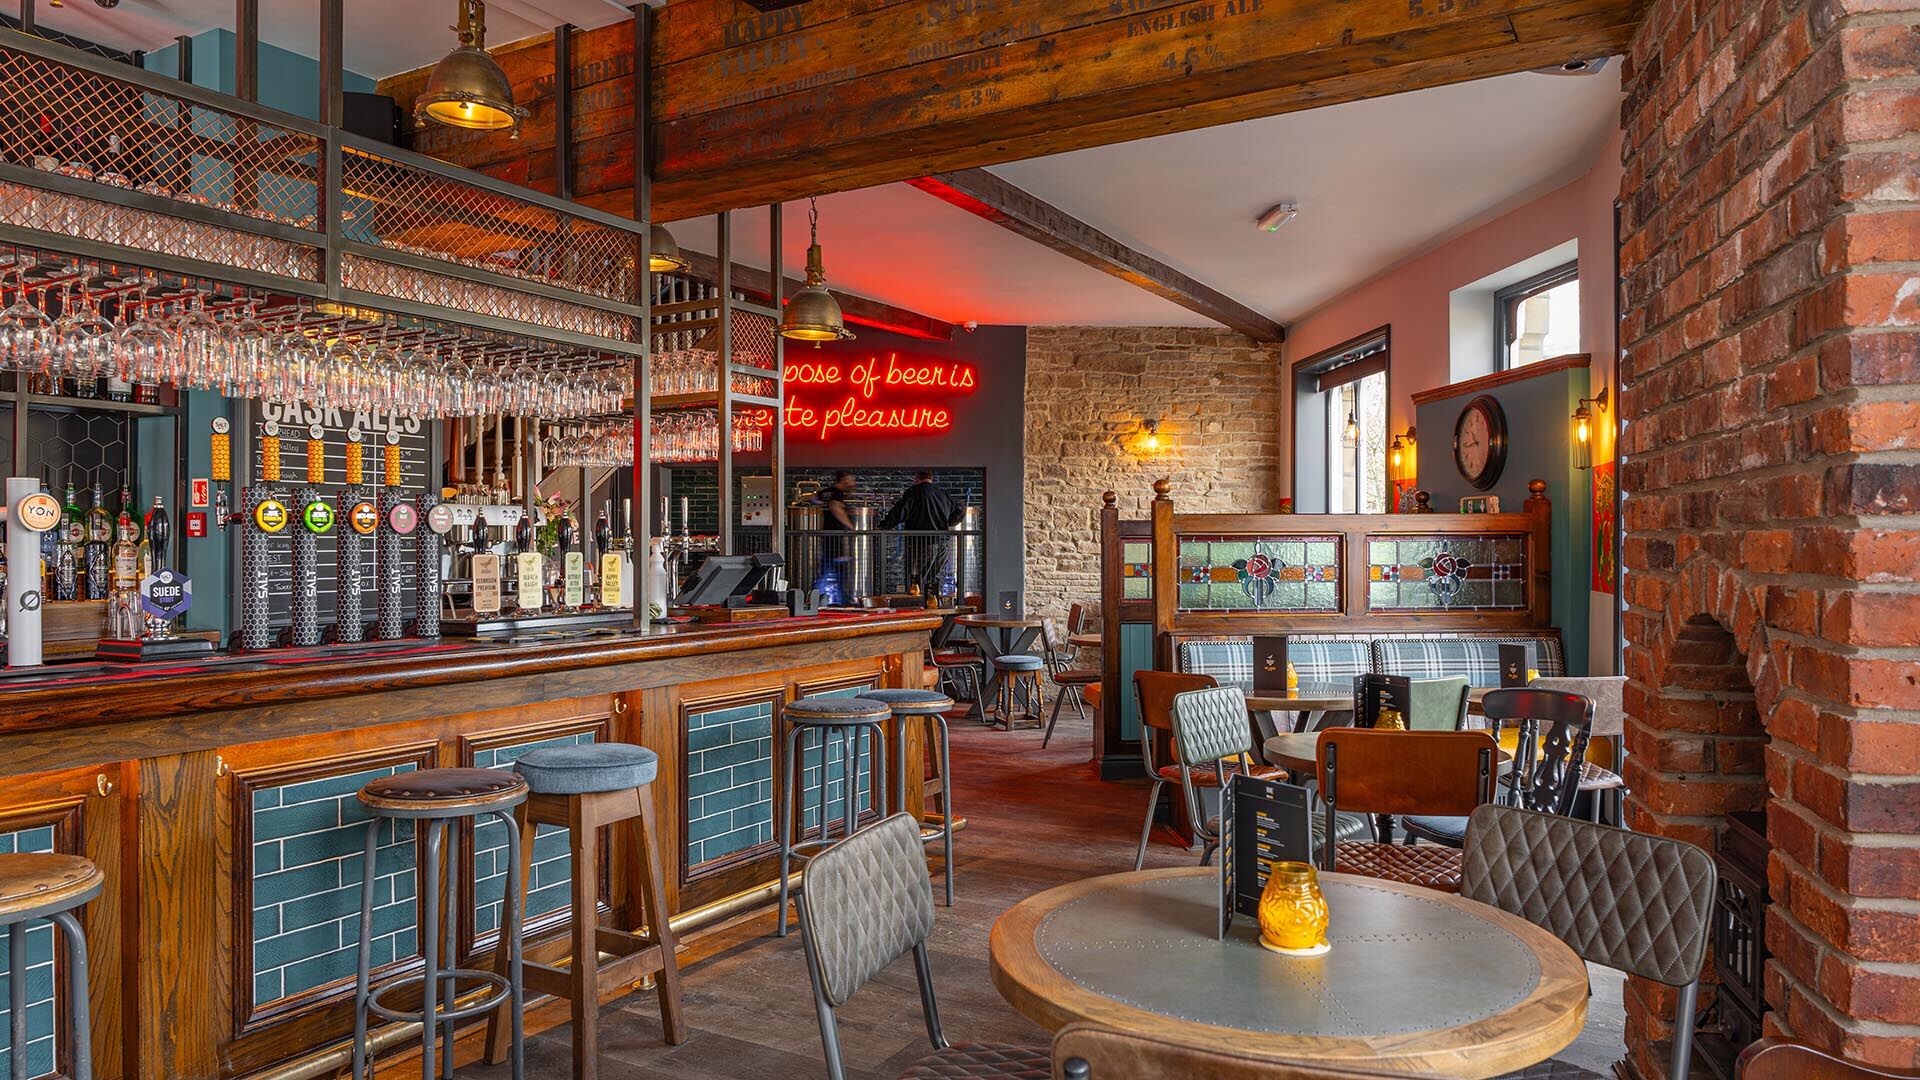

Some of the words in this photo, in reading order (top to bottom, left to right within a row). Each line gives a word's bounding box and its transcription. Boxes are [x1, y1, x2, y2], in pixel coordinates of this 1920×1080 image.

[723, 7, 803, 48] HAPPY
[1127, 5, 1215, 37] ENGLISH
[850, 357, 881, 398] of
[886, 353, 946, 385] beer
[950, 364, 974, 387] is
[821, 397, 950, 440] pleasure
[29, 505, 54, 517] YON
[152, 585, 181, 597] SUEDE
[257, 571, 268, 599] SALT
[306, 569, 317, 597] SALT
[351, 569, 361, 595] SALT
[391, 568, 401, 593] SALT
[428, 568, 439, 593] SALT
